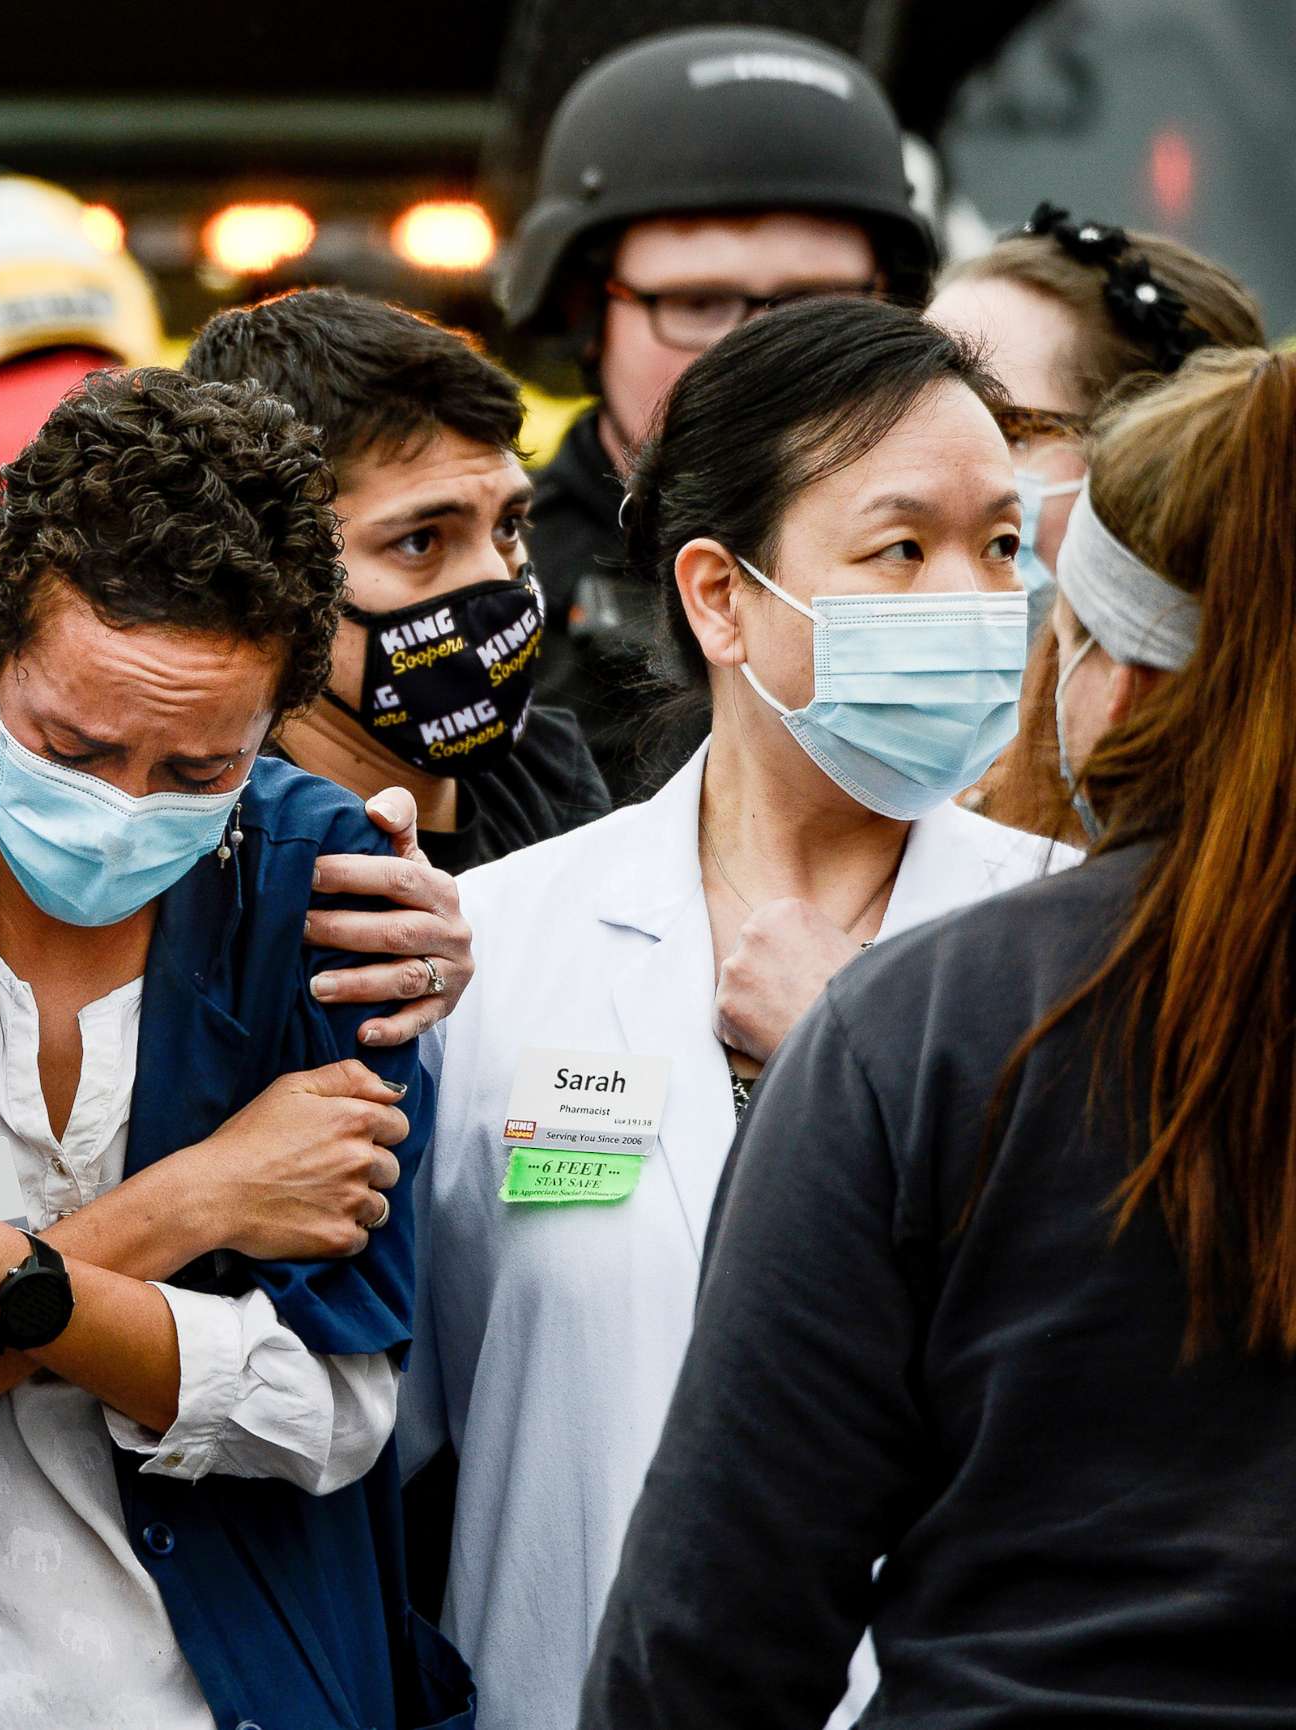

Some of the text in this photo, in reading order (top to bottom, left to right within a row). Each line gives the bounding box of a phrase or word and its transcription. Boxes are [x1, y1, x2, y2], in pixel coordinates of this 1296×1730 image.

[380, 607, 455, 655] KING
[476, 608, 537, 669] KING
[391, 637, 464, 675] Soopers
[419, 699, 499, 746] KING
[428, 721, 504, 760] Soopers
[554, 1068, 626, 1094] Sarah
[559, 1104, 611, 1116] Pharmacist
[546, 1131, 643, 1145] Serving You Since 2006
[534, 1176, 602, 1189] STAY SAFE
[556, 1161, 608, 1177] FEET
